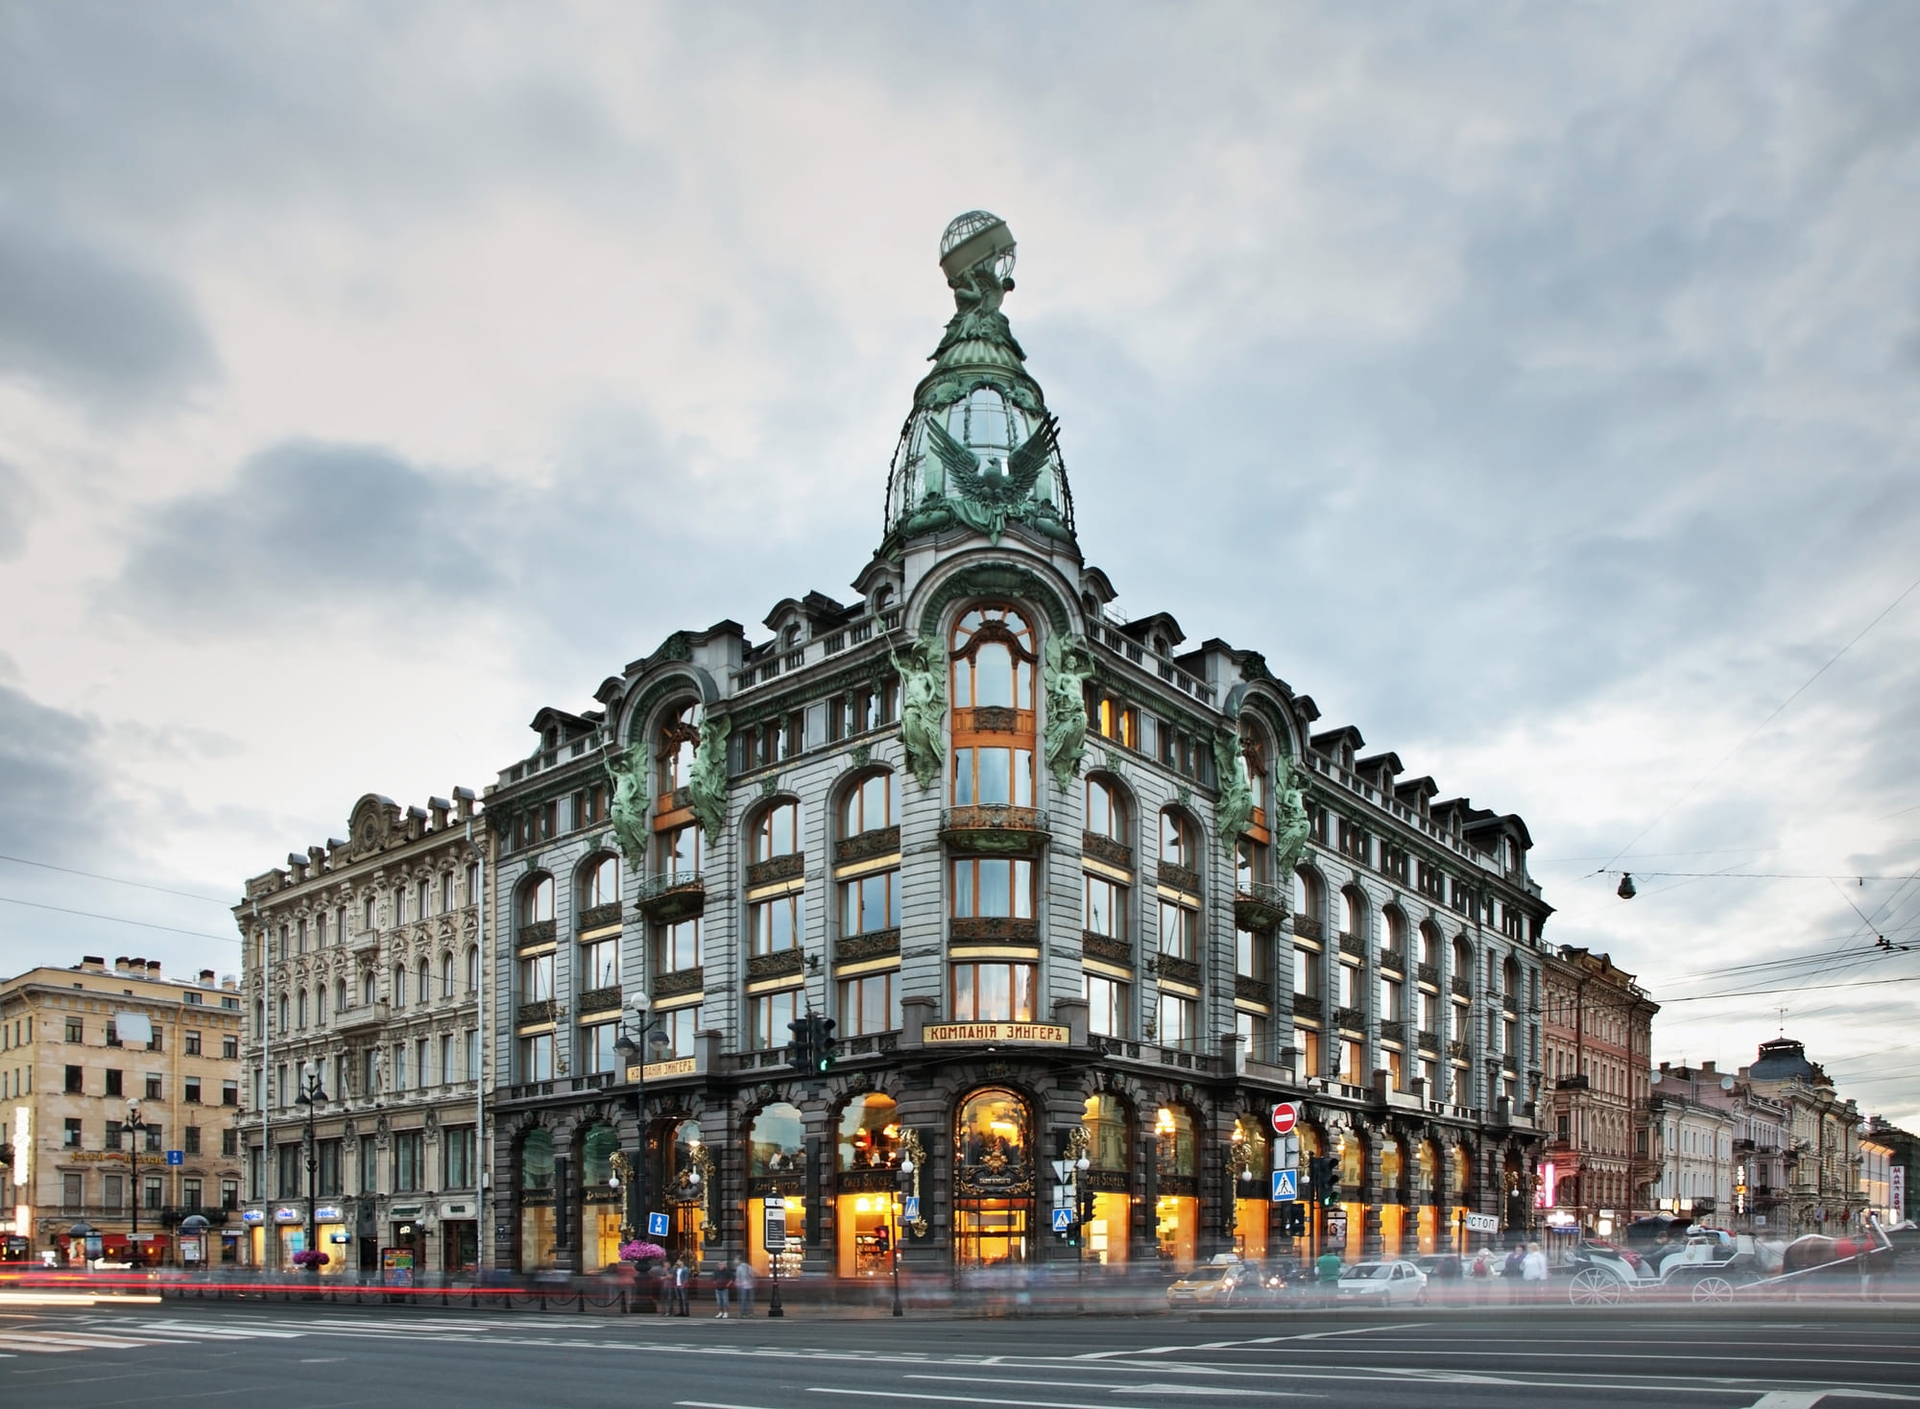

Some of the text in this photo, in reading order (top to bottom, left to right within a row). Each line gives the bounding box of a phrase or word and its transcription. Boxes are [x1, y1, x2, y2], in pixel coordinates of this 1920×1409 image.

[930, 1025, 1062, 1041] КОМПАНІЯ ЗИНГЕРЪ
[631, 1064, 662, 1080] КОПАНІЯ
[1471, 1217, 1495, 1229] СТОП
